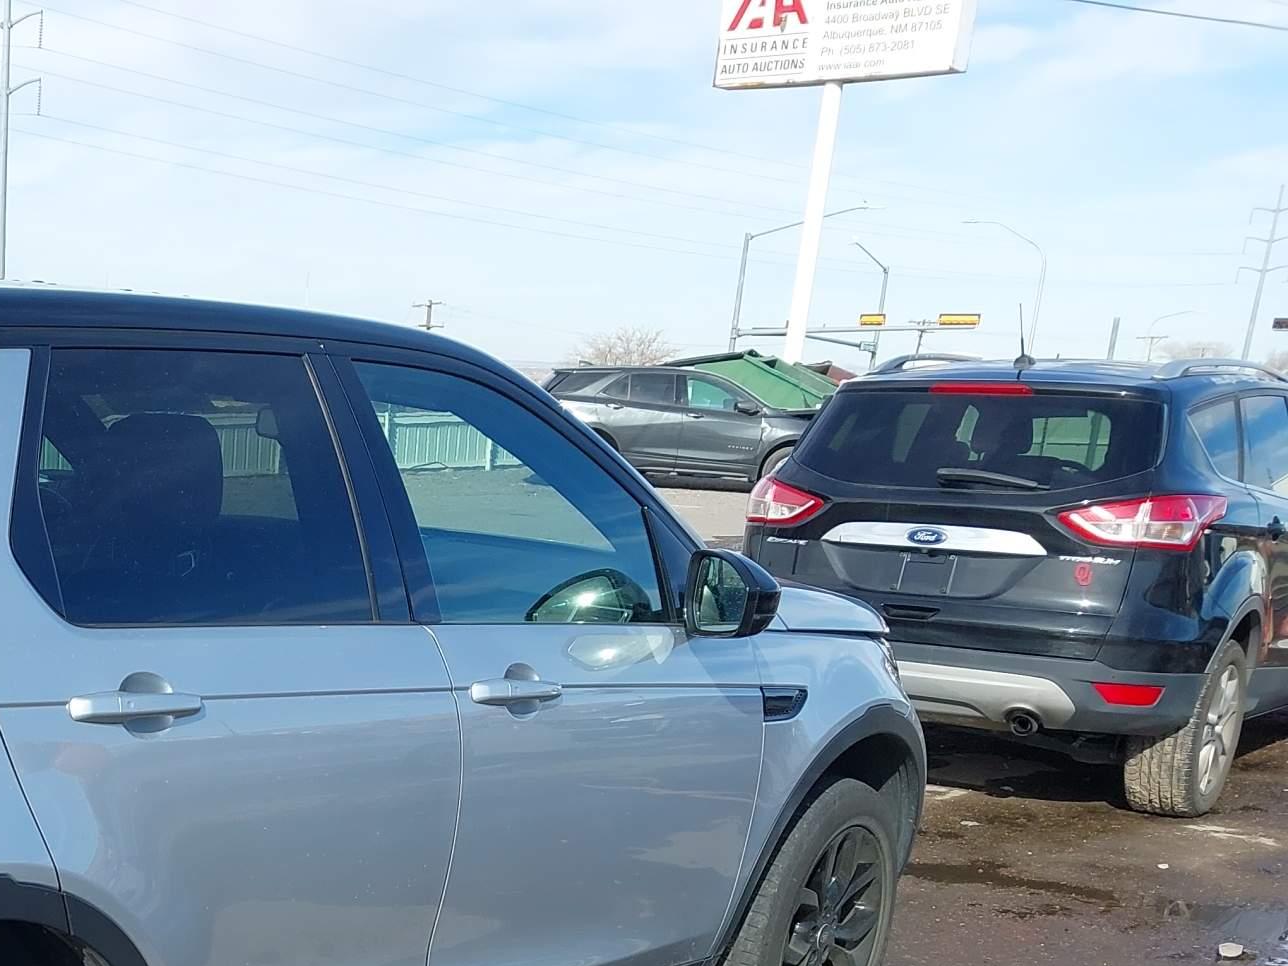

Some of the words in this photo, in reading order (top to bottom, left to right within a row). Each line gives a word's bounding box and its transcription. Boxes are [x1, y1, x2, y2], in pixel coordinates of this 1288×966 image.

[824, 14, 849, 25] 4400
[852, 9, 900, 24] Broadway
[903, 5, 933, 18] BLVD
[935, 3, 951, 15] SE
[826, 0, 878, 11] Insurance
[890, 23, 908, 34] NM
[910, 20, 943, 33] 87105
[723, 37, 809, 56] INSURANCE
[839, 43, 866, 56] (505)
[868, 39, 915, 53] 873-2081
[720, 62, 750, 76] AUTO
[751, 57, 807, 73] AUCTIONS
[914, 530, 938, 542] Ford
